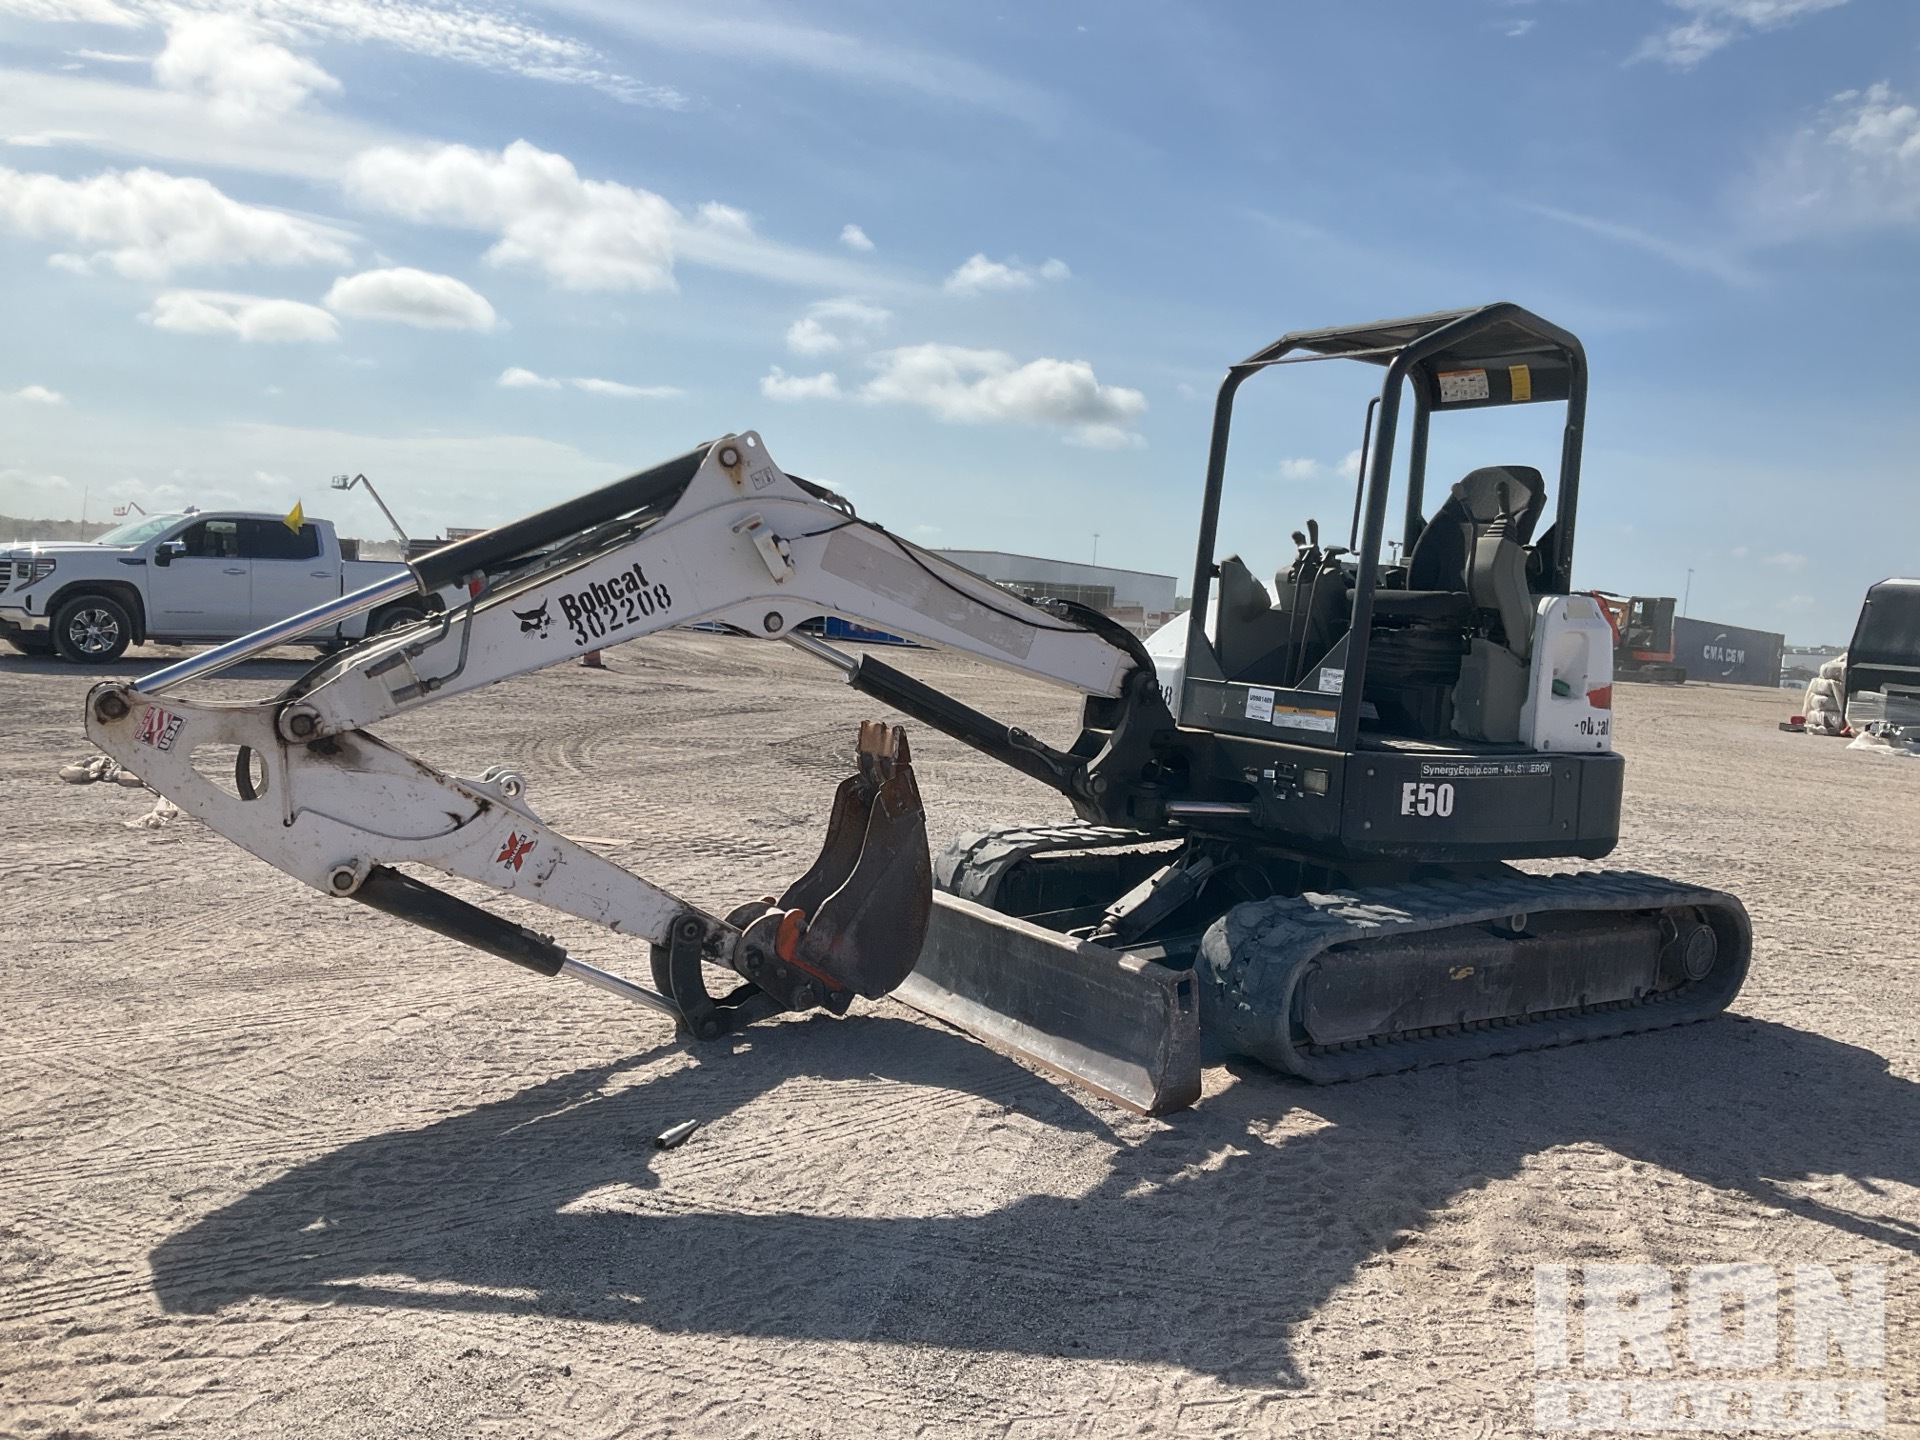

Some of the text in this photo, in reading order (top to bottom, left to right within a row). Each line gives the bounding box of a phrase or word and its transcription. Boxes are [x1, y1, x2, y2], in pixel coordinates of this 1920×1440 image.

[558, 563, 649, 622] Bobcat
[569, 584, 672, 646] 302208
[1703, 645, 1723, 661] CMA
[158, 720, 182, 750] USA
[1423, 765, 1498, 776] SynergyEquip.com
[1401, 783, 1454, 817] E50
